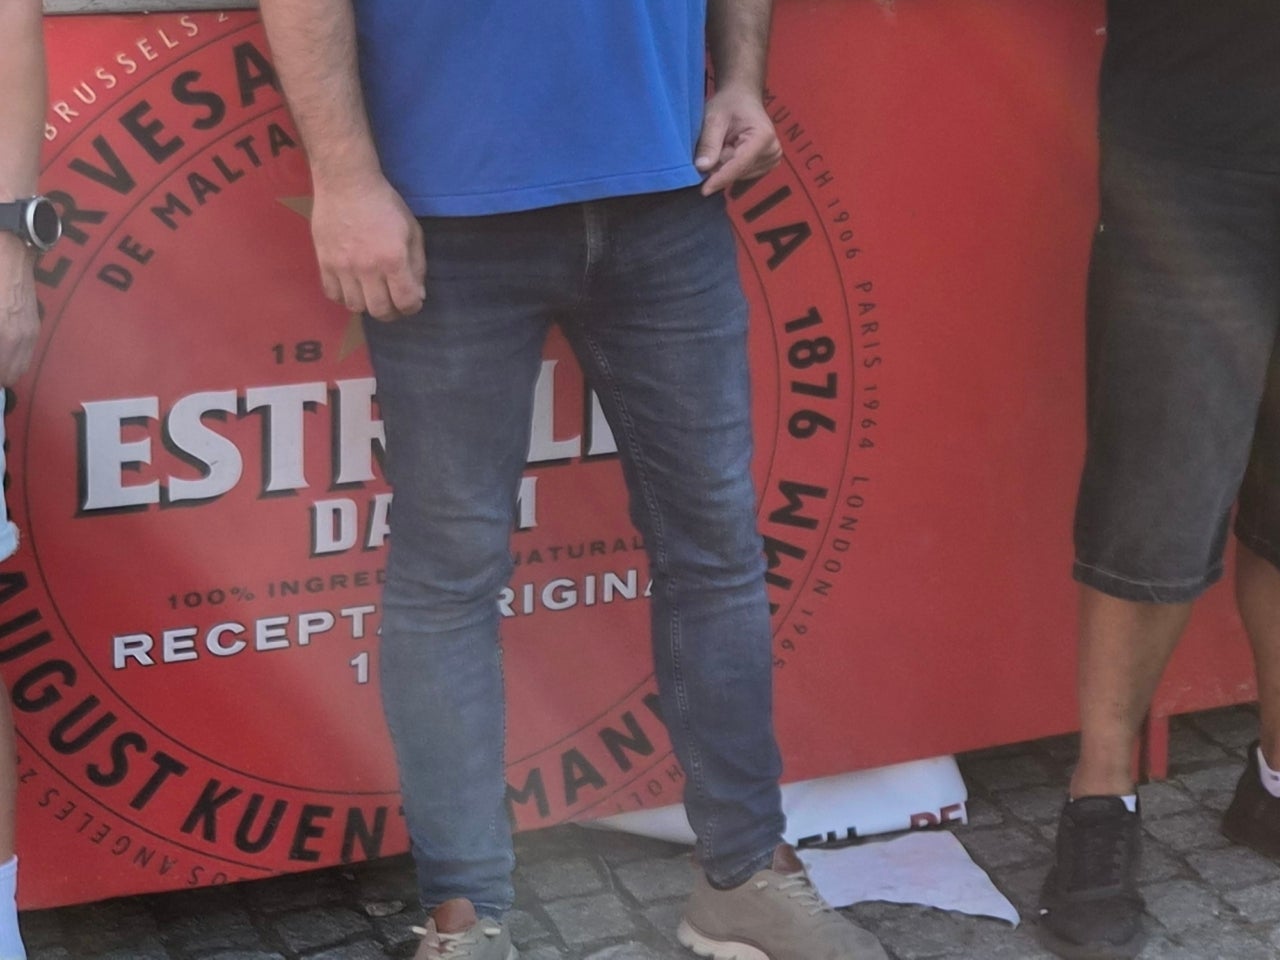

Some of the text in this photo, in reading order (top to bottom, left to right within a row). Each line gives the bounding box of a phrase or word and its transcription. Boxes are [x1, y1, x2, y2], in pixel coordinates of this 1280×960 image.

[43, 14, 199, 142] BRUSSELS
[97, 122, 299, 292] DE MALTA
[856, 281, 882, 369] PARIS
[785, 306, 837, 439] 1876
[859, 385, 880, 449] 1964
[813, 476, 870, 596] LONDON
[112, 605, 382, 670] RECEPT
[168, 584, 256, 610] 100%
[38, 789, 180, 875] ANGELES
